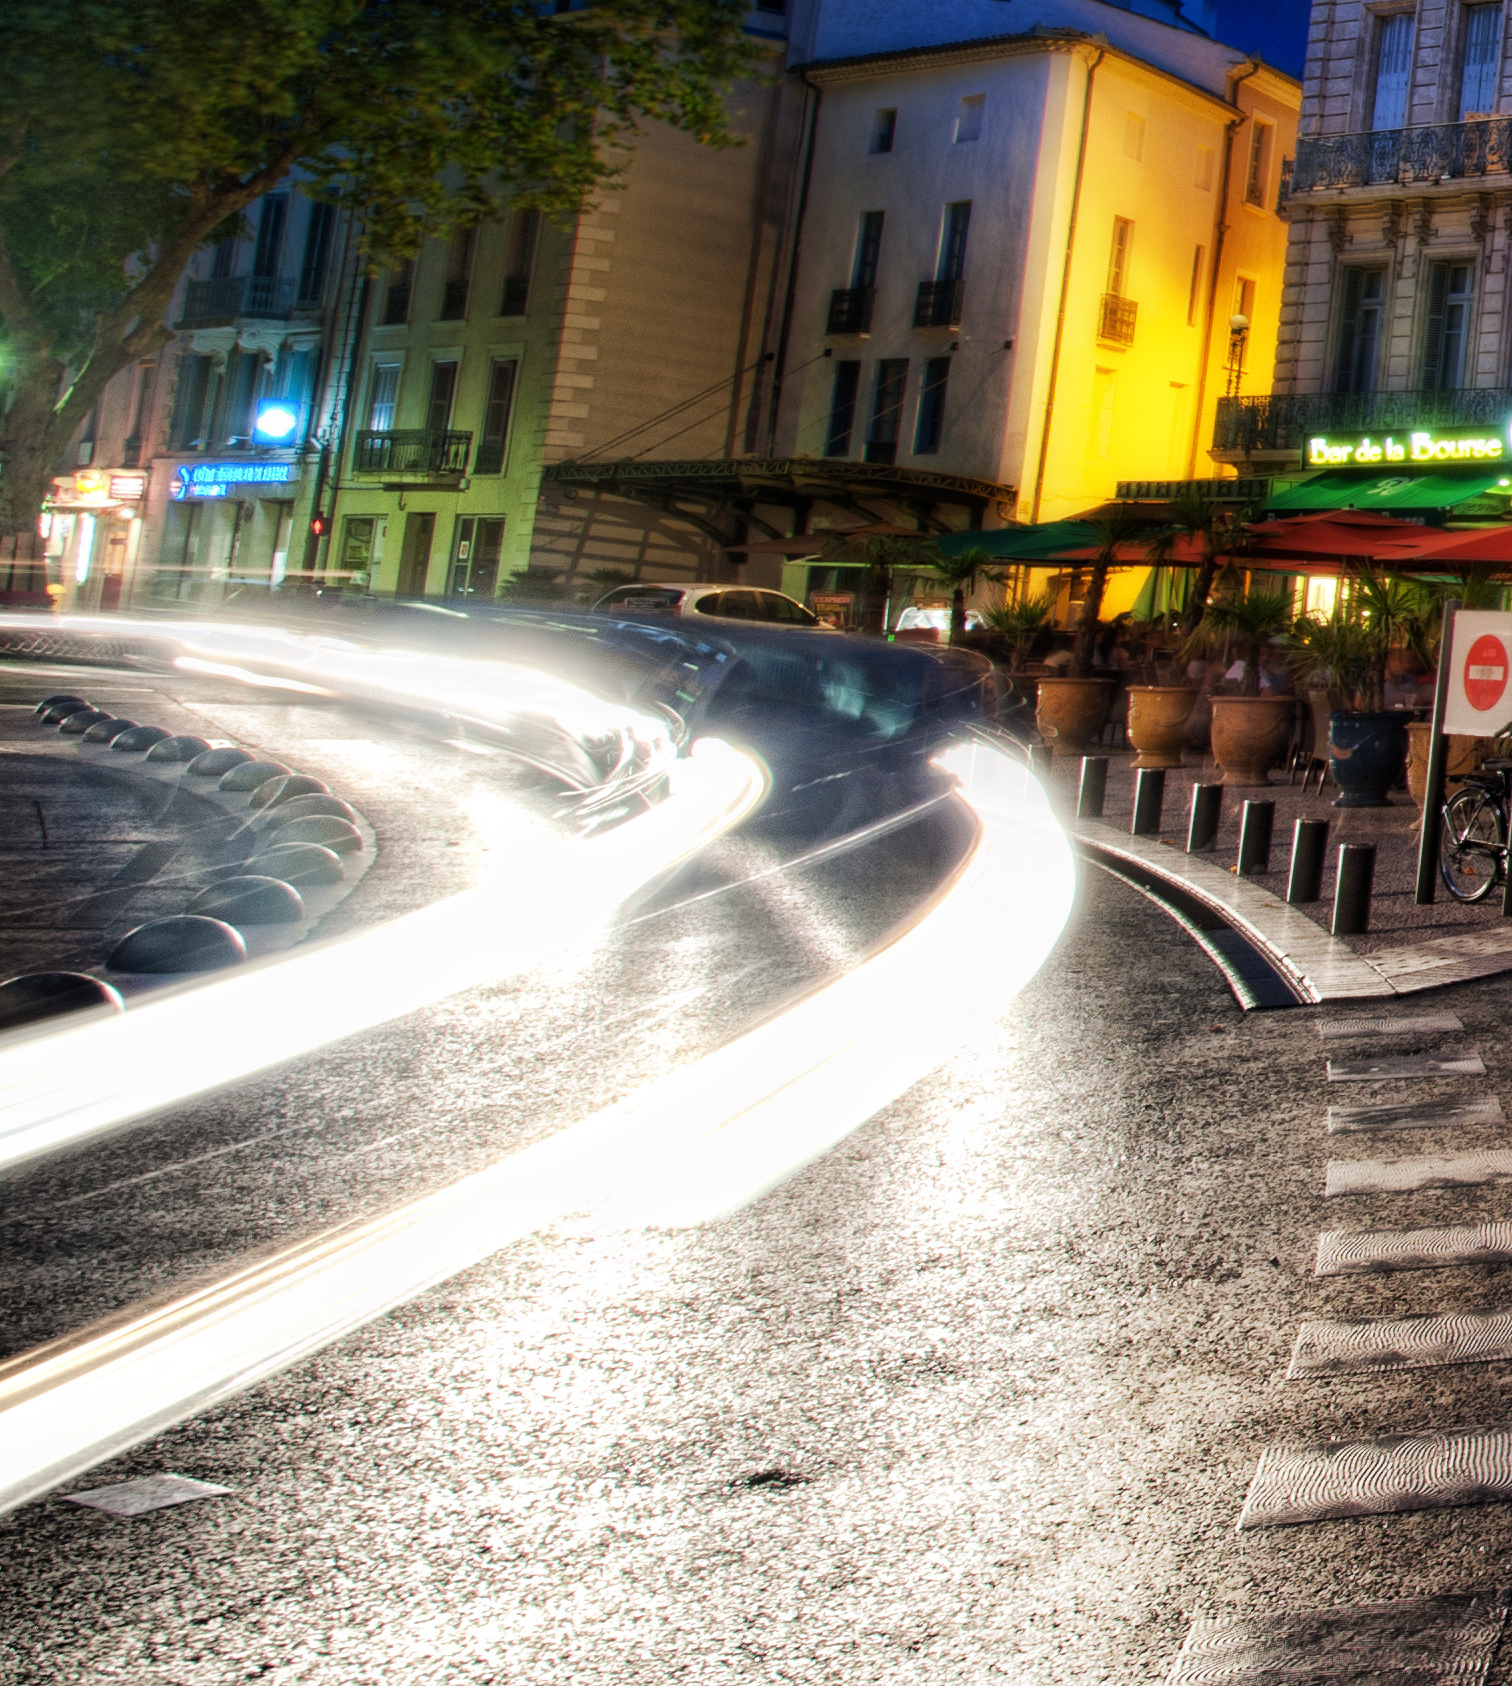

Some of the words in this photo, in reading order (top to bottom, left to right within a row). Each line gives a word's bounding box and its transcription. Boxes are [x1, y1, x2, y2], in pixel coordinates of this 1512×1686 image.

[1310, 437, 1353, 464] Bar
[1355, 437, 1382, 462] de
[1384, 436, 1405, 460] la
[1410, 431, 1502, 460] Bourse
